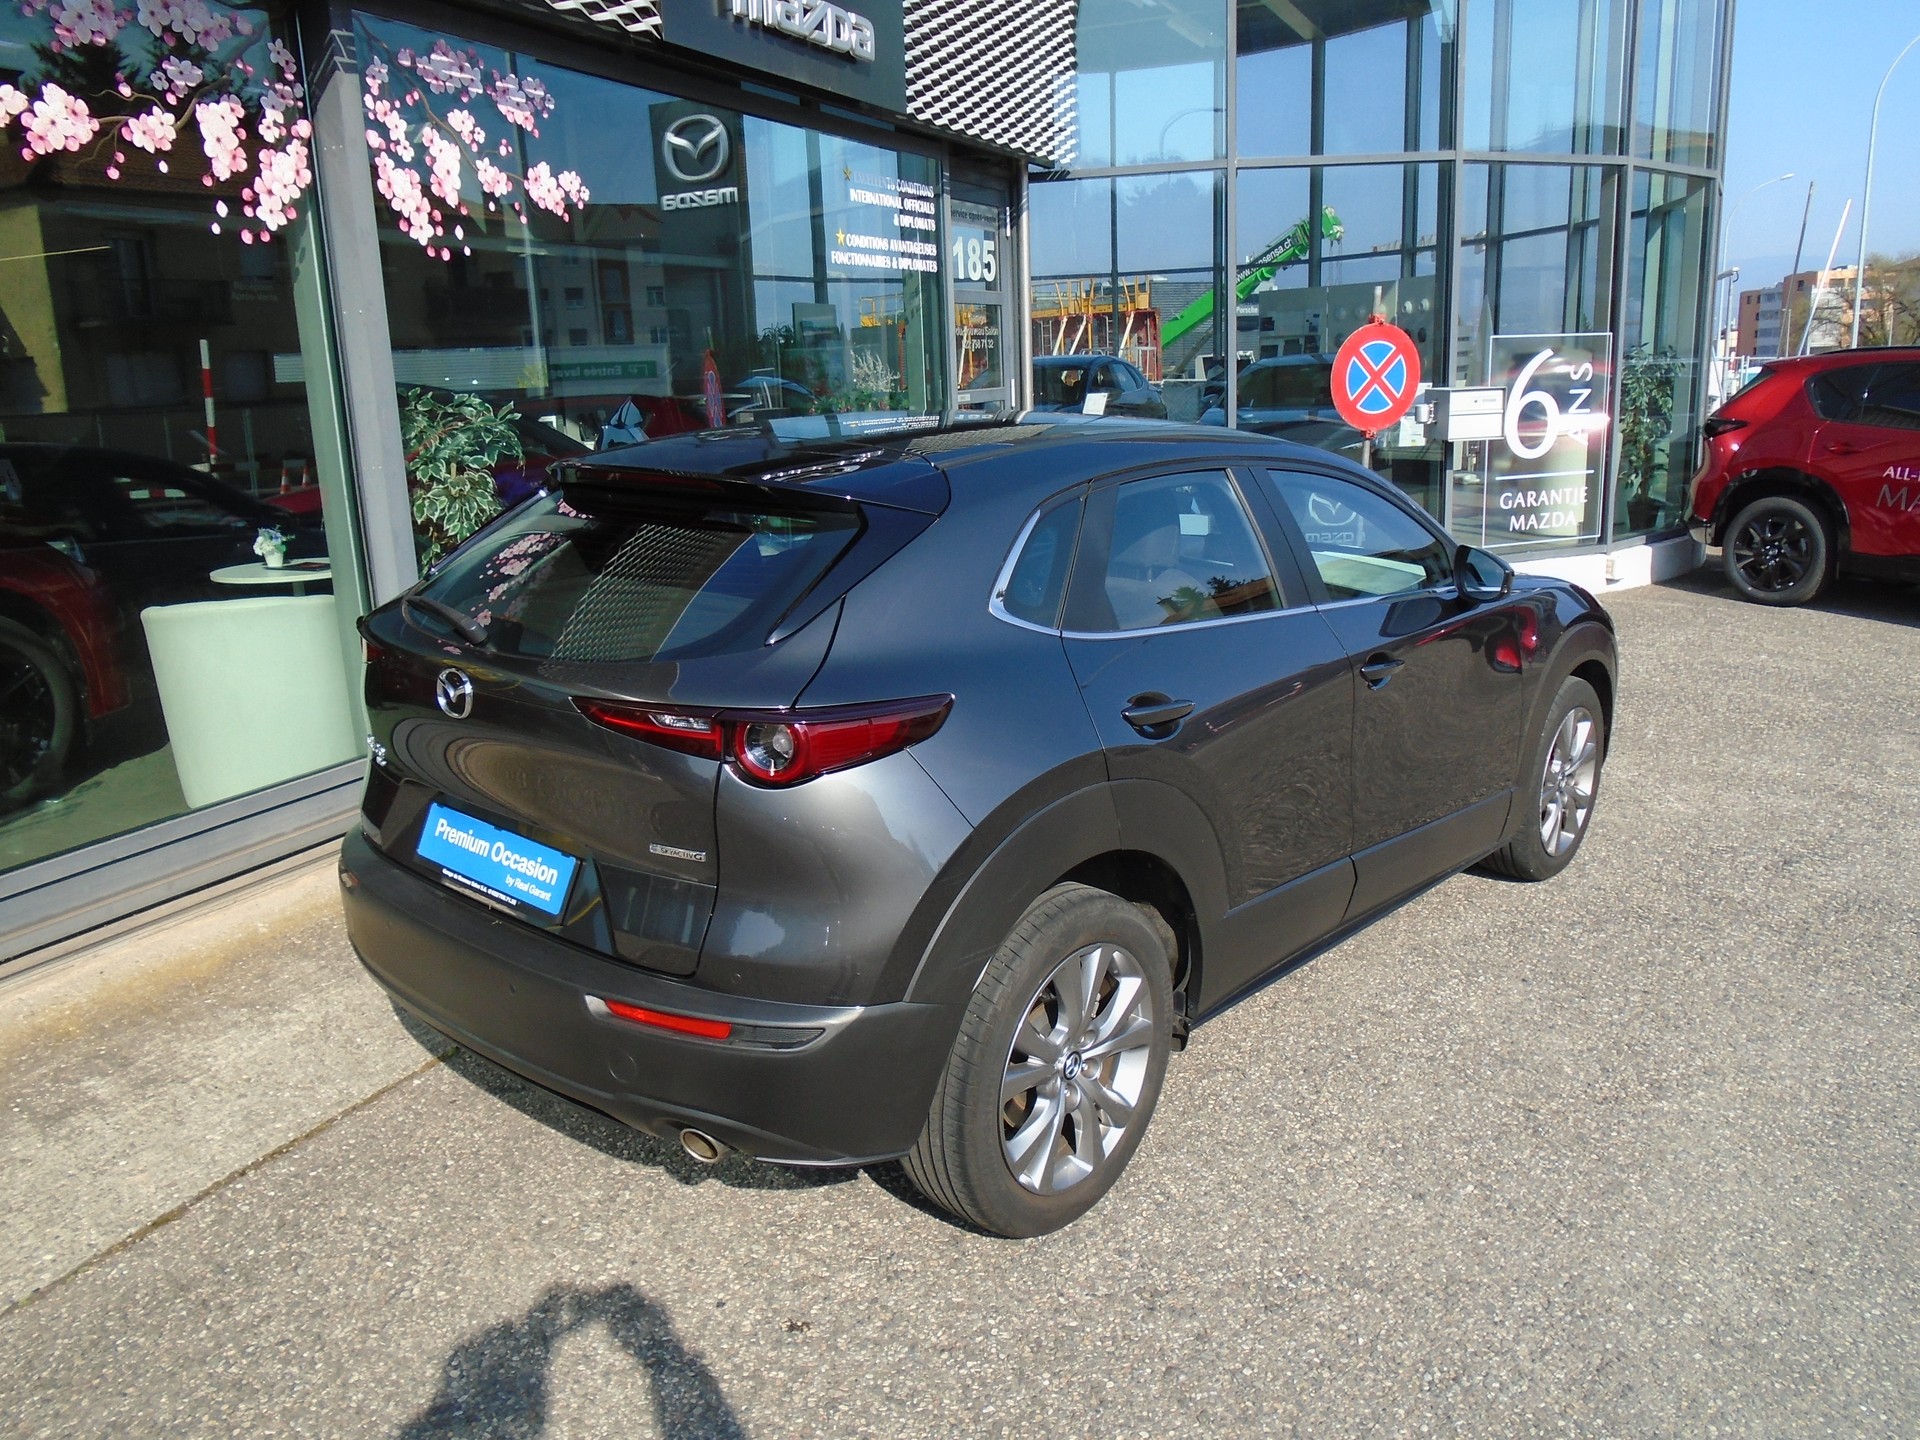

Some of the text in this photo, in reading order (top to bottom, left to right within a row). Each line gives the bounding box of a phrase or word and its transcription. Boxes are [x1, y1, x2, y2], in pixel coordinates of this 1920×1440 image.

[896, 179, 934, 199] CONDITIONS
[849, 188, 935, 215] INTERNATIONAL OFFICIALS
[893, 213, 936, 232] & DIPLOMATS
[846, 233, 937, 257] CONDITIONS AVANTAGEUSES
[831, 250, 938, 273] FONCTIONNAIRES & DIPLOMATES
[953, 236, 996, 282] 185
[1236, 306, 1258, 314] Porsche
[1504, 348, 1561, 460] 6
[1499, 486, 1589, 510] GARANTIE
[1508, 511, 1578, 532] MAZDA
[434, 817, 559, 886] Premium Occasion
[505, 873, 516, 888] by
[515, 877, 530, 893] Real
[529, 884, 552, 902] Garant
